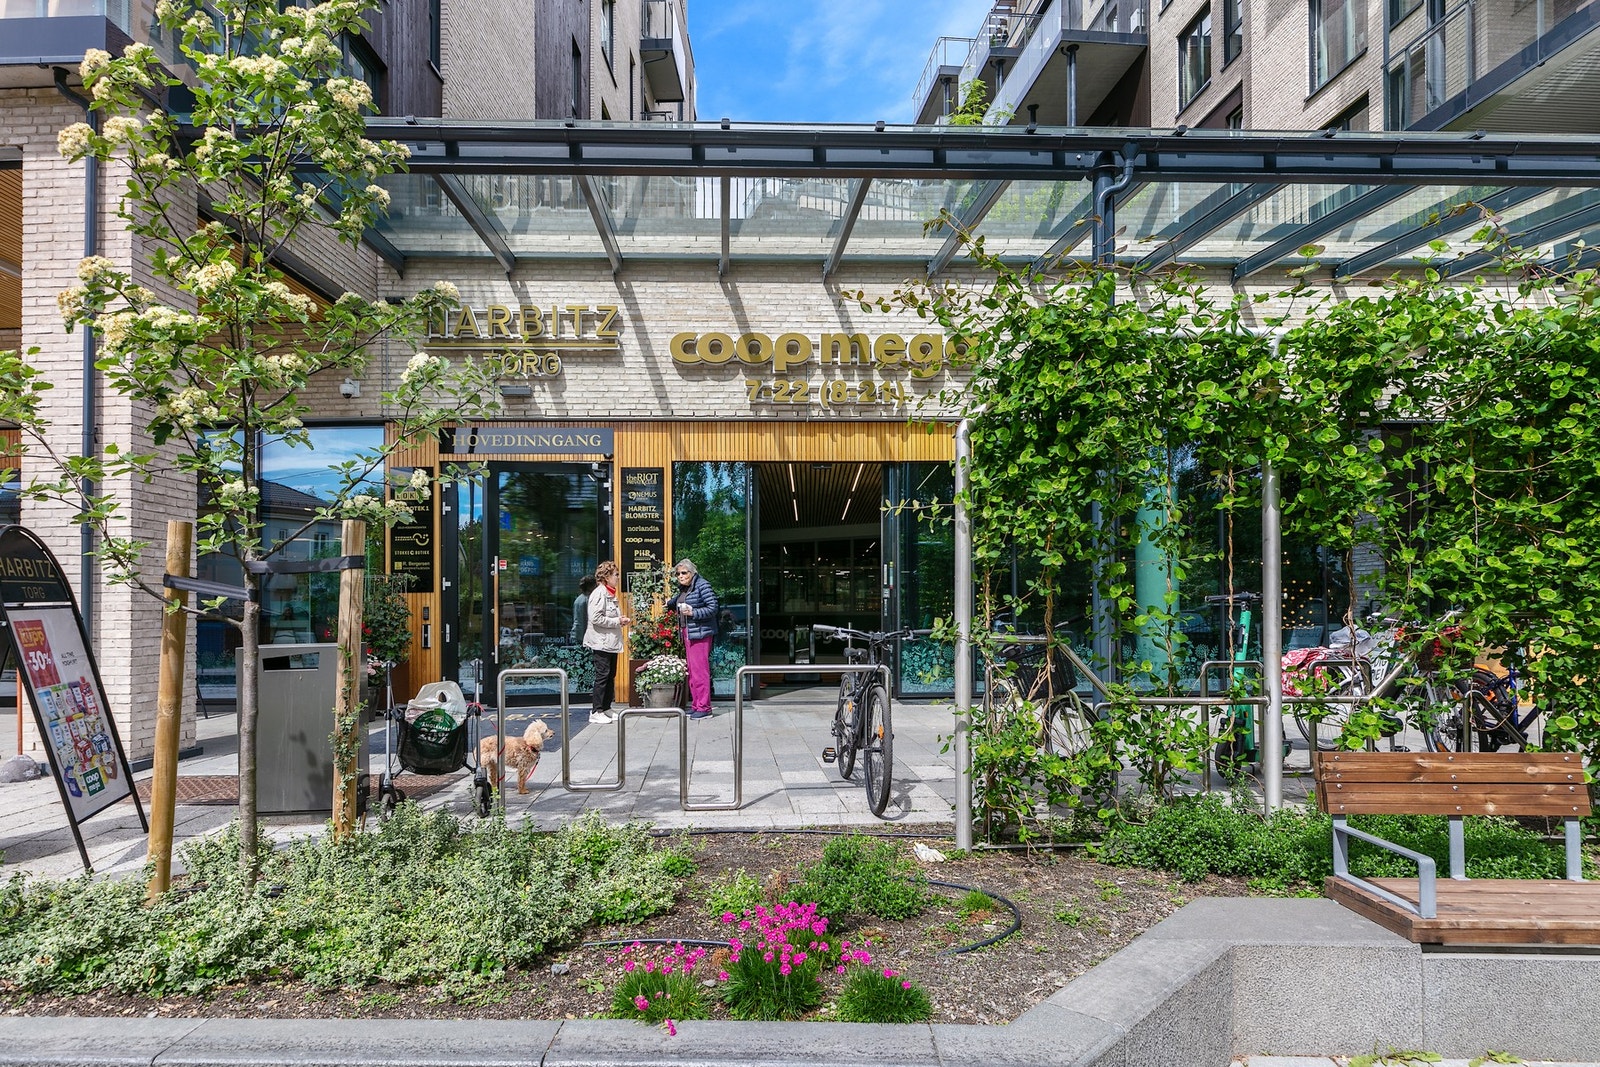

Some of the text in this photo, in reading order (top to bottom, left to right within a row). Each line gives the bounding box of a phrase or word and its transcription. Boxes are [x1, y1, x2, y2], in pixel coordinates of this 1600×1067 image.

[669, 331, 813, 373] coop
[482, 352, 562, 376] TORG
[745, 379, 905, 409] 7-22 (8-21)
[451, 434, 602, 448] HOVEDINNGANG
[21, 586, 46, 599] TORG
[28, 650, 52, 671] -30%
[85, 772, 100, 784] coop
